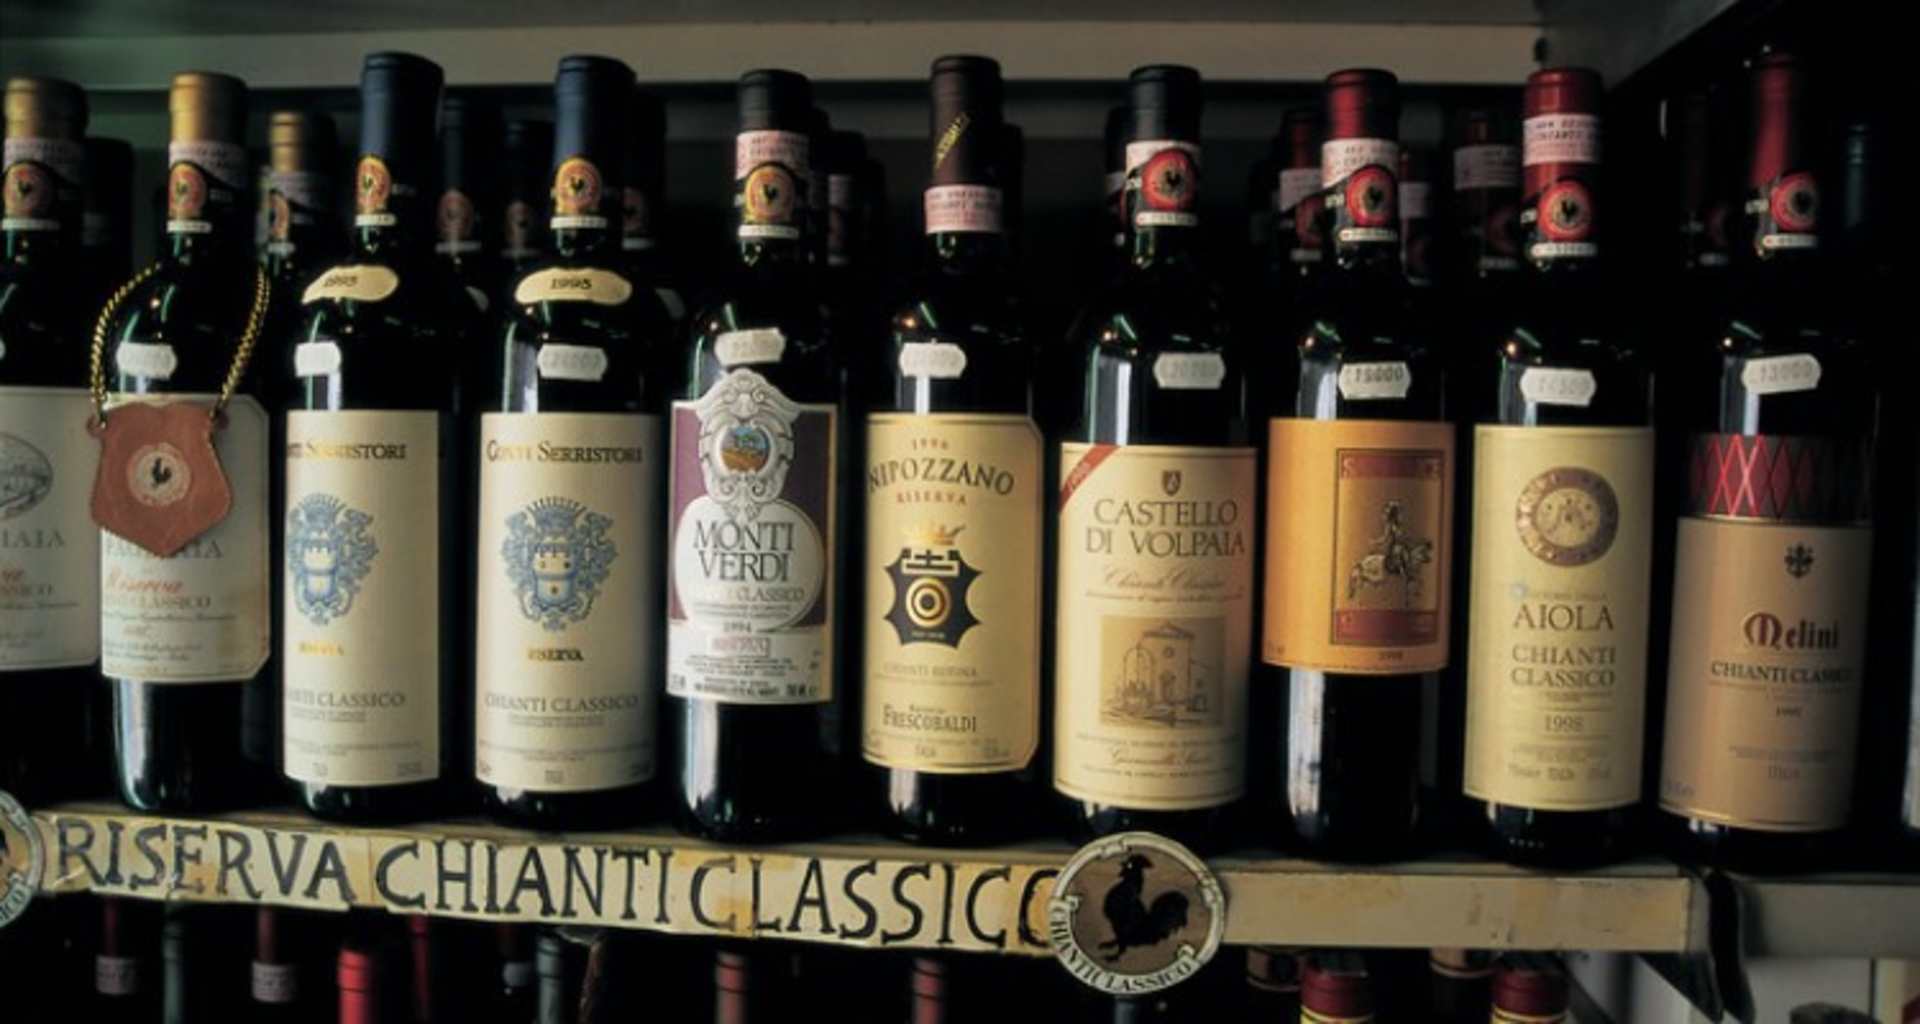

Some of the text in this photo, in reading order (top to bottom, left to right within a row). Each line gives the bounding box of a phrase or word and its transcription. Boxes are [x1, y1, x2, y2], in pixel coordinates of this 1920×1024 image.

[537, 440, 643, 463] SERRISTORI
[869, 458, 1015, 497] NIPOZZANO
[1093, 498, 1239, 527] CASTELLO
[694, 519, 795, 551] MONTI
[1085, 528, 1245, 558] DI VOLPAIA
[698, 551, 790, 582] VERDI
[1513, 603, 1614, 631] AIOLA
[1744, 612, 1839, 651] Melini
[1511, 644, 1616, 665] CHIANTI
[1510, 667, 1616, 688] CLASSICO
[1711, 661, 1787, 683] CHIANTI
[317, 692, 406, 708] CLASSICO
[485, 692, 640, 713] CHIANTI CLASSICO
[882, 704, 977, 733] FRESCOBALDI
[56, 817, 357, 902] RISERVA
[374, 839, 674, 924] CHIANTI
